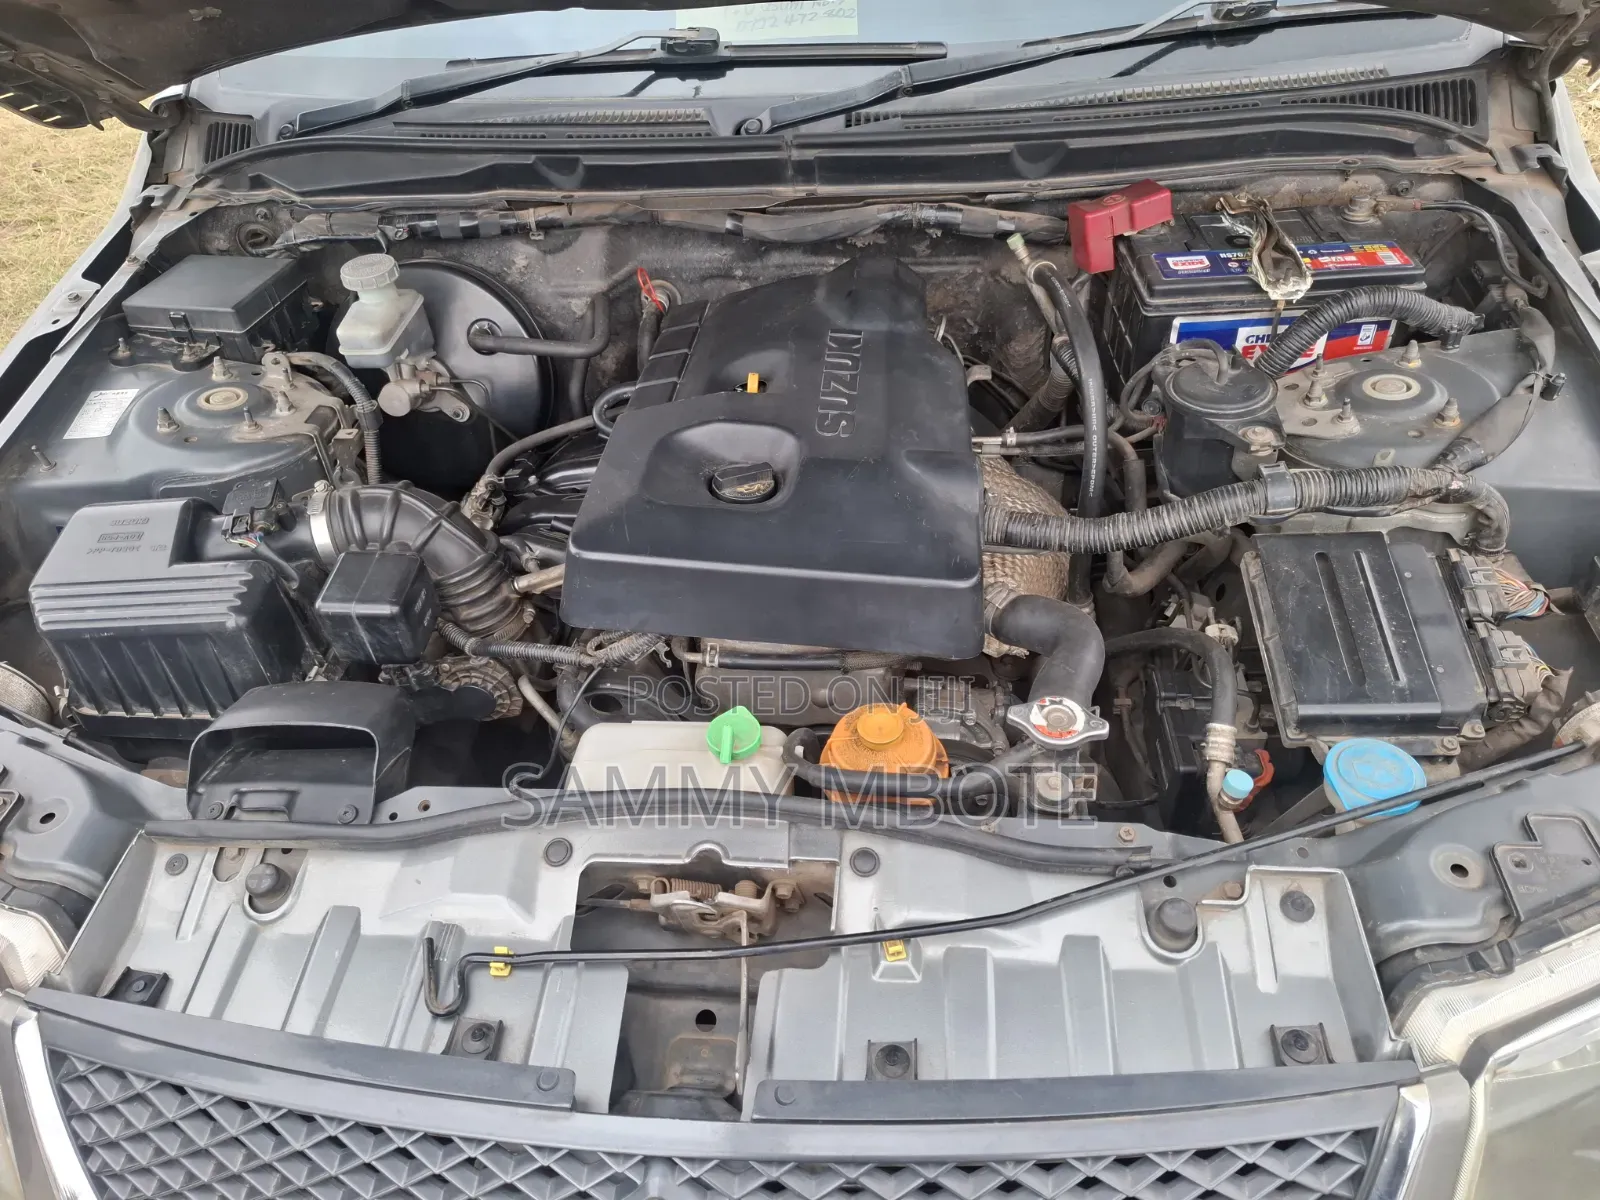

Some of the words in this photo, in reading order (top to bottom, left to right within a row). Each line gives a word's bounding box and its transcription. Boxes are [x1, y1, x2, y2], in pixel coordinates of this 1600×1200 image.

[784, 12, 818, 26] 472
[1172, 260, 1206, 268] EXIDE
[815, 329, 864, 438] SUZUKI
